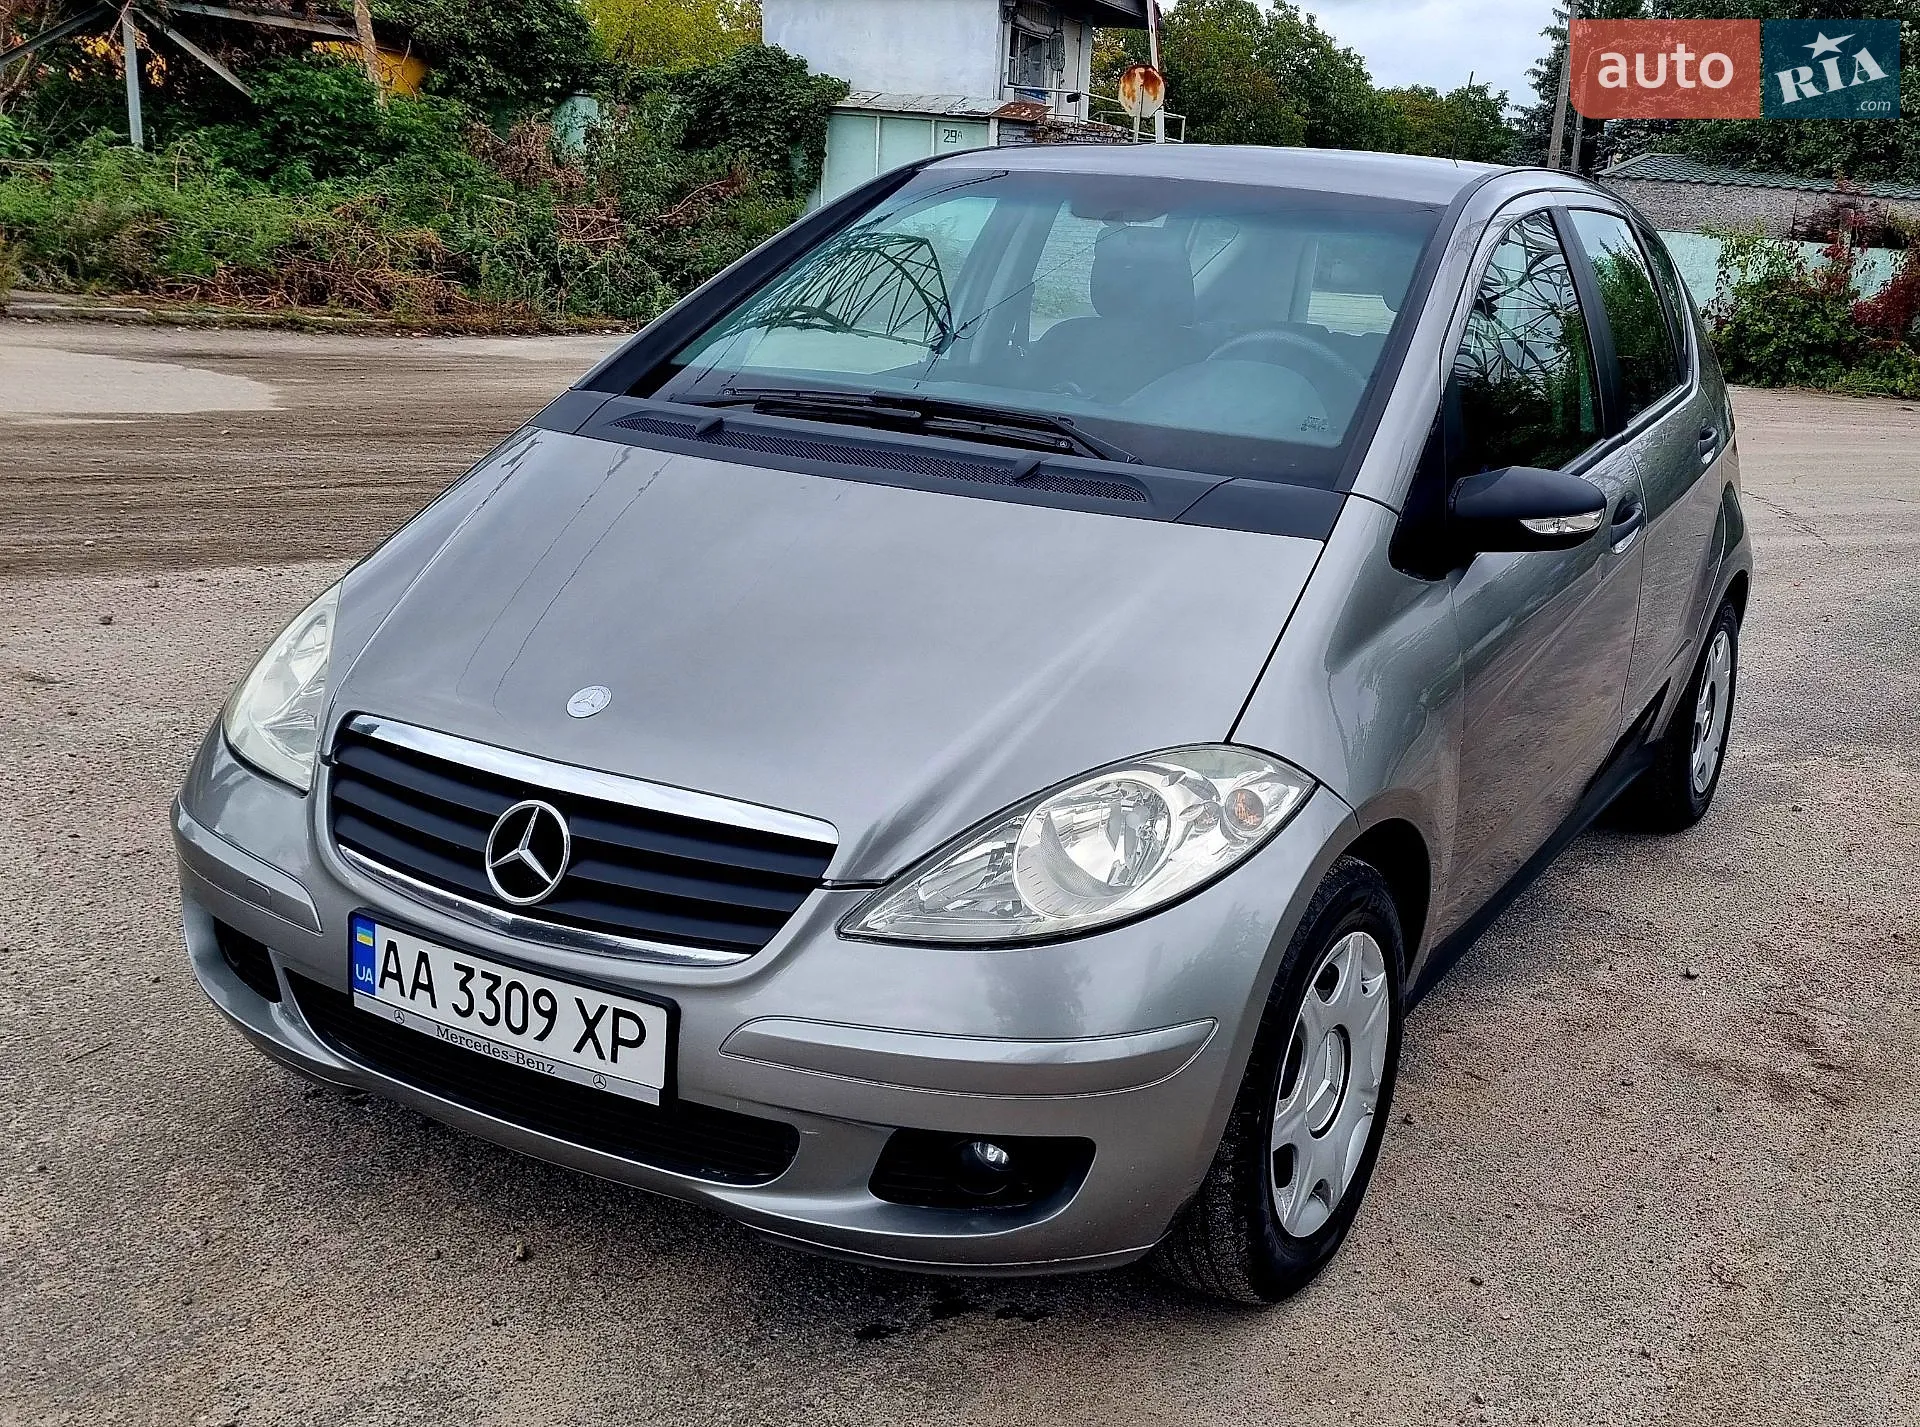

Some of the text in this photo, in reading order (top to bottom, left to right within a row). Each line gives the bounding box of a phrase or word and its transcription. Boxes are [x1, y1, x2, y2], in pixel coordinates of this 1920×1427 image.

[356, 963, 374, 985] UA
[378, 939, 647, 1063] AA 3309 XP
[436, 1024, 556, 1076] Mercedes-Benz
